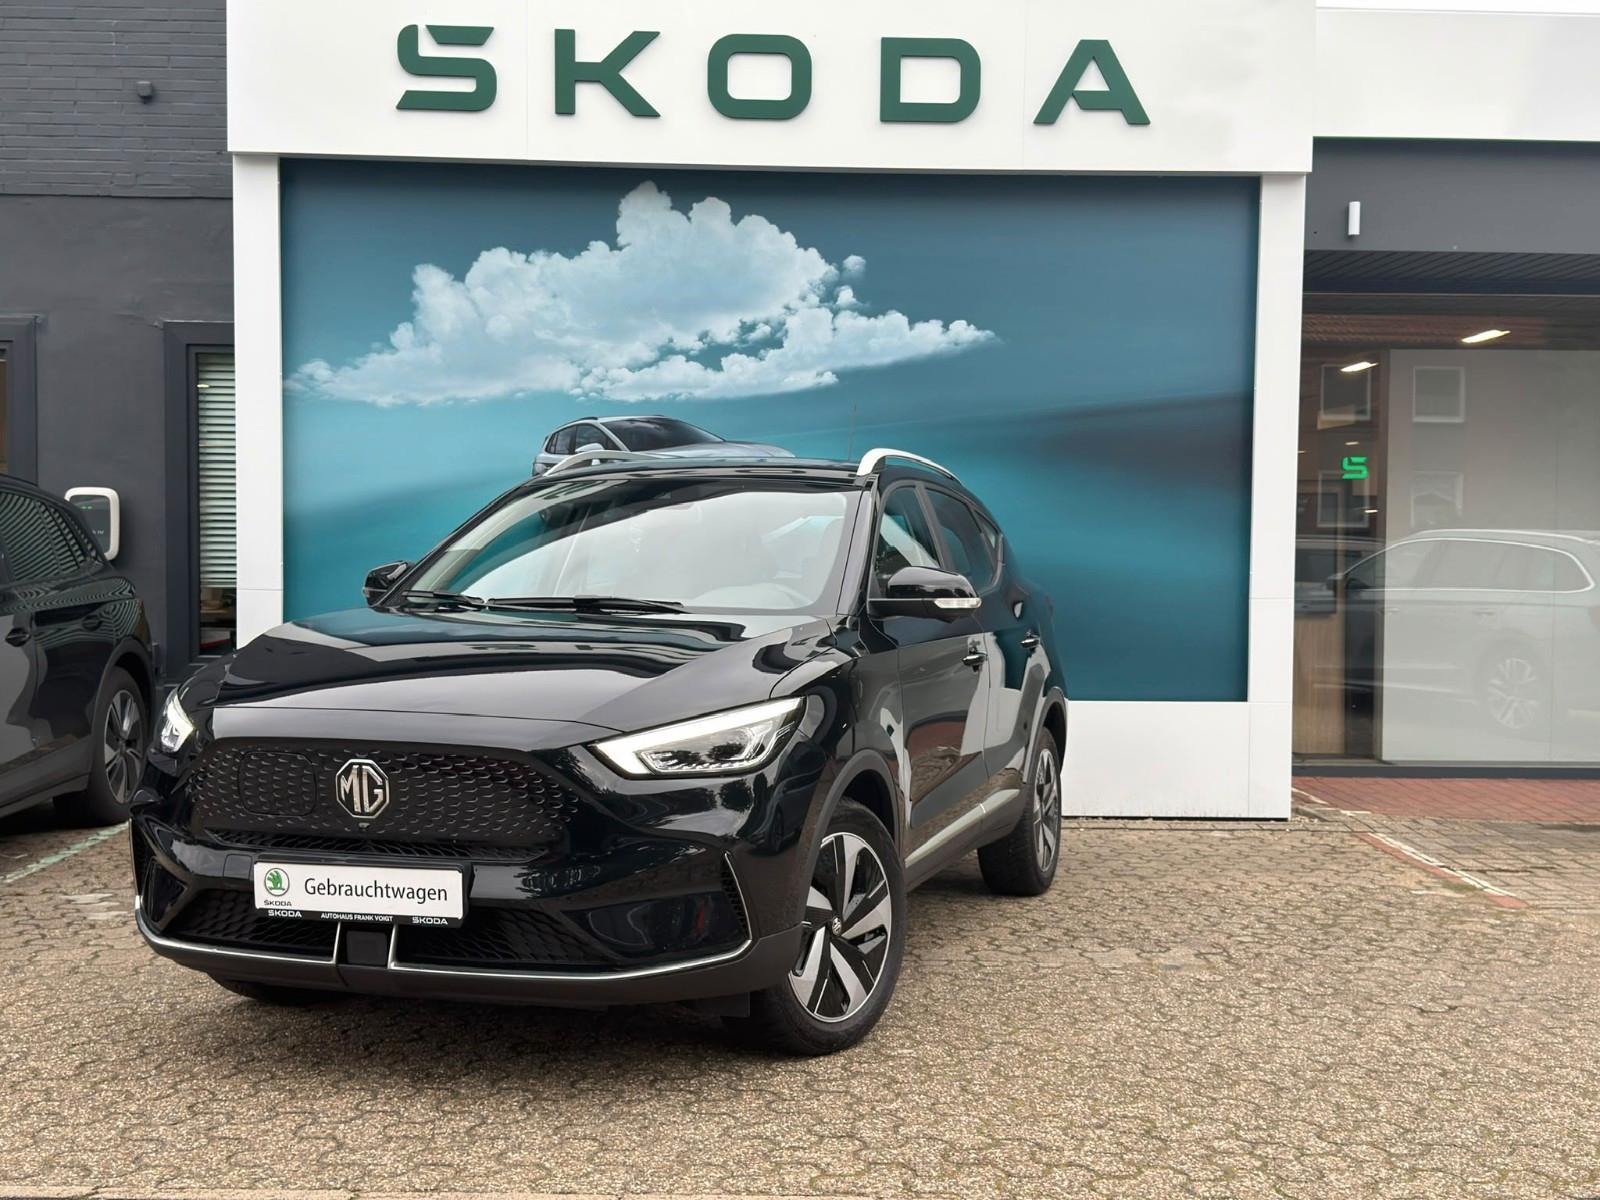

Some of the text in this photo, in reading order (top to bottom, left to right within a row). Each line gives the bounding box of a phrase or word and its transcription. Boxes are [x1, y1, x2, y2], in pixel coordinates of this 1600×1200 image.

[340, 764, 384, 813] MG
[304, 877, 448, 904] Gebrauchtwagen
[320, 912, 353, 920] AUTOHAUS
